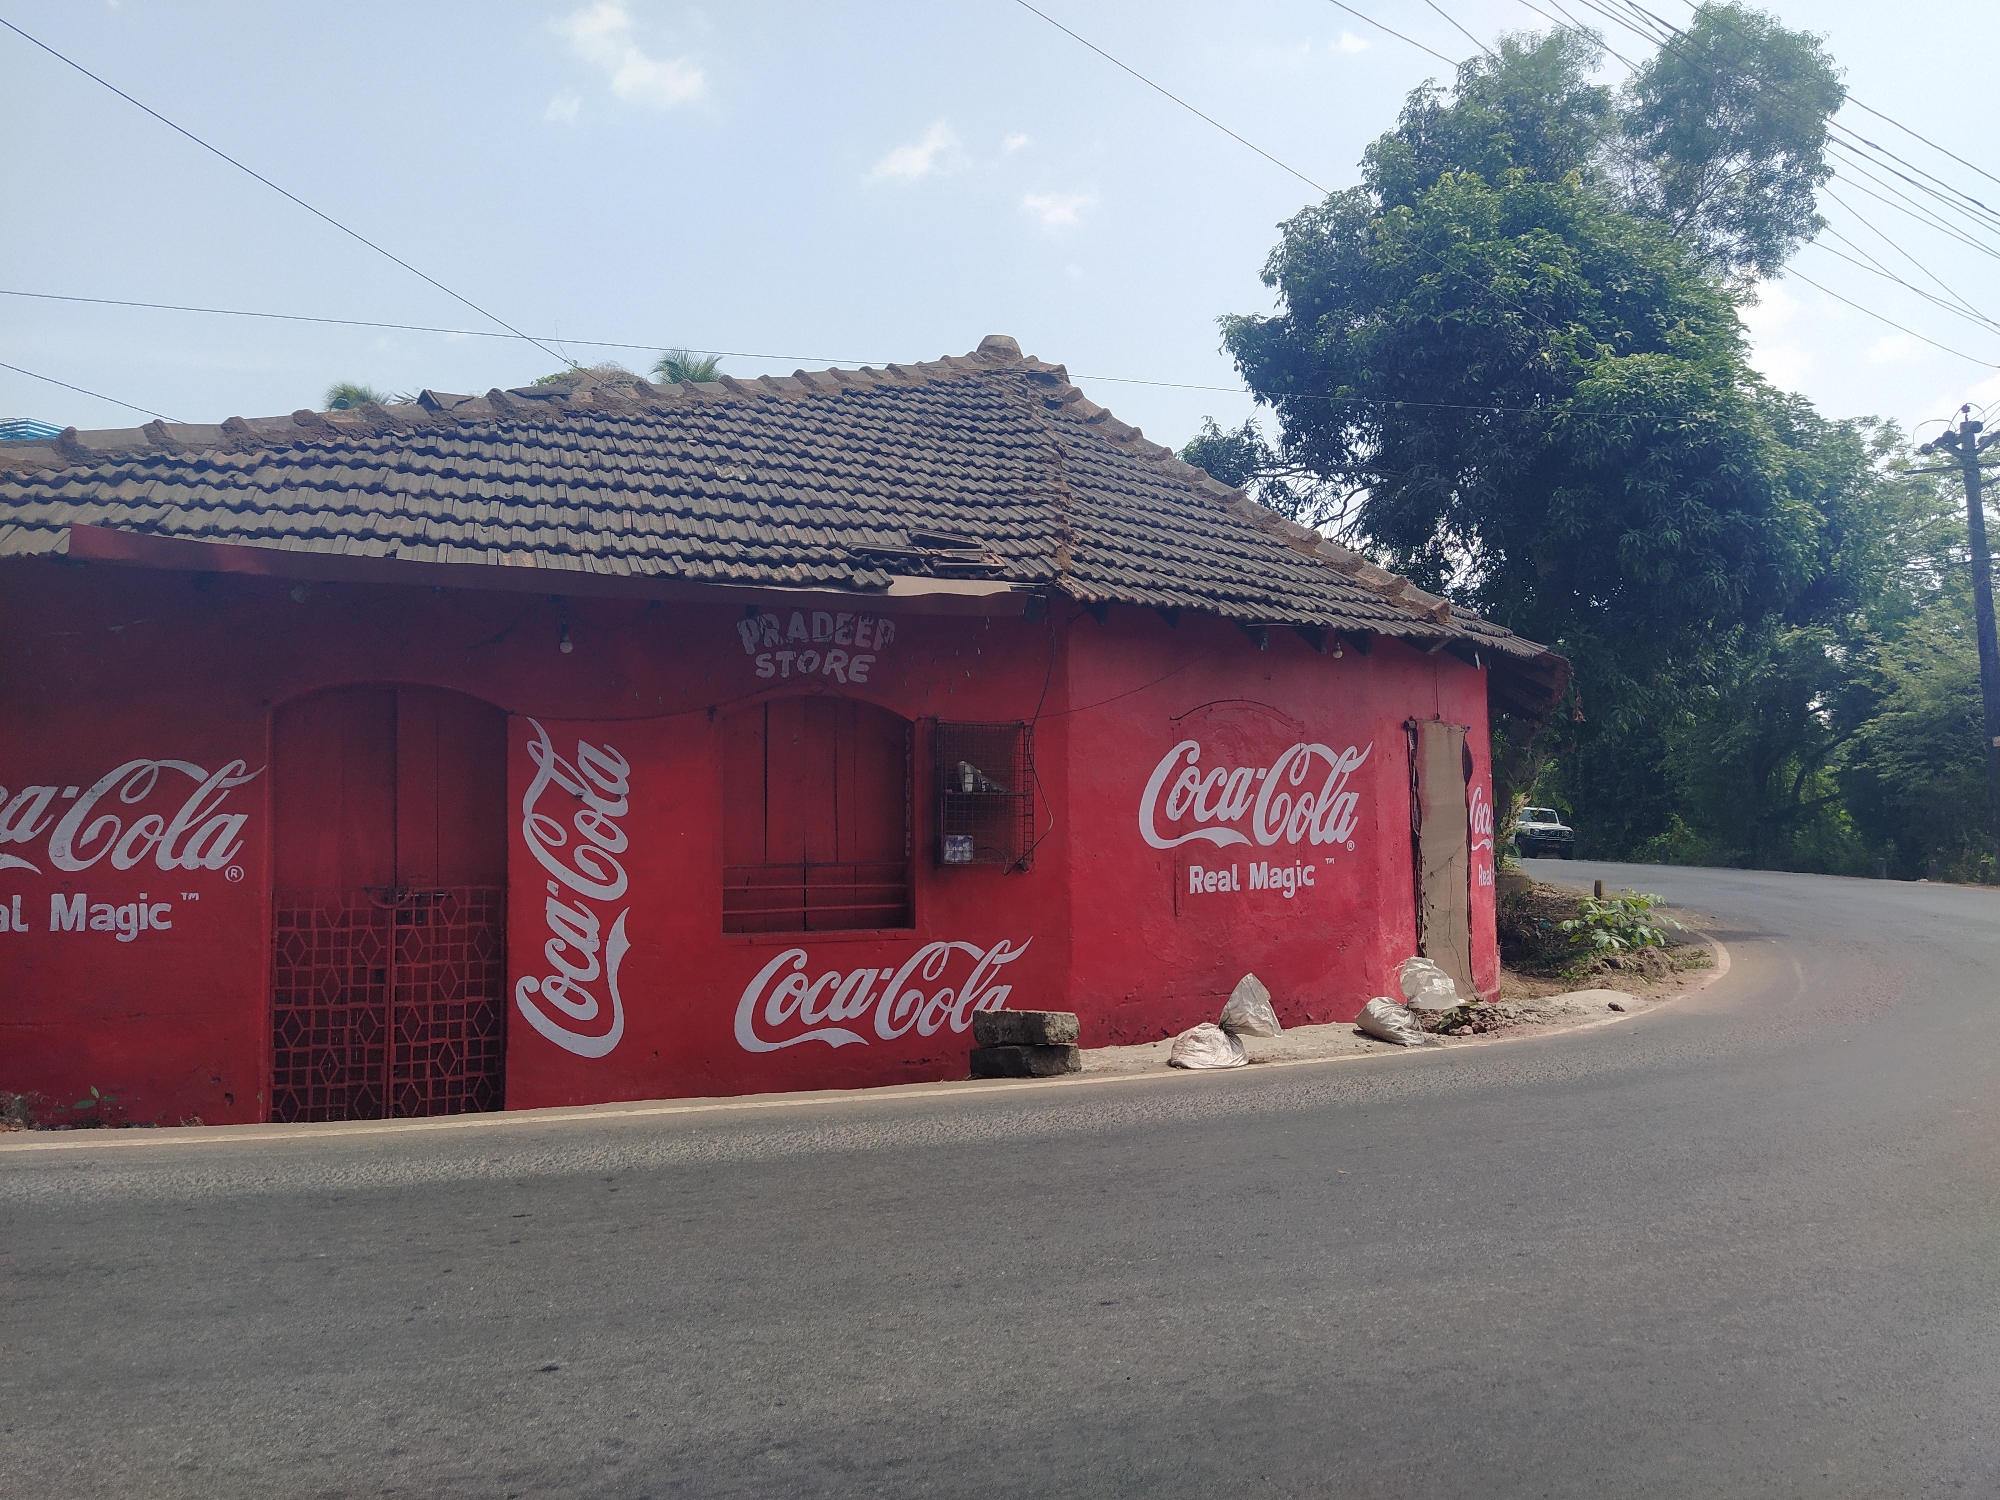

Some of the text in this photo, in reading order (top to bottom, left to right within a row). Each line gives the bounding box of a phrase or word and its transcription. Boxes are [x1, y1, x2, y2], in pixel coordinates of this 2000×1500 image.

[737, 611, 896, 655] PRADEEP
[755, 649, 876, 684] STORE
[0, 759, 266, 875] a-Cola
[1139, 740, 1373, 849] Coca-Cola
[516, 717, 631, 1058] Coca-Cola
[1189, 864, 1241, 894] Real
[1249, 859, 1315, 898] Magic
[1478, 863, 1492, 887] Real
[49, 893, 172, 942] Magic
